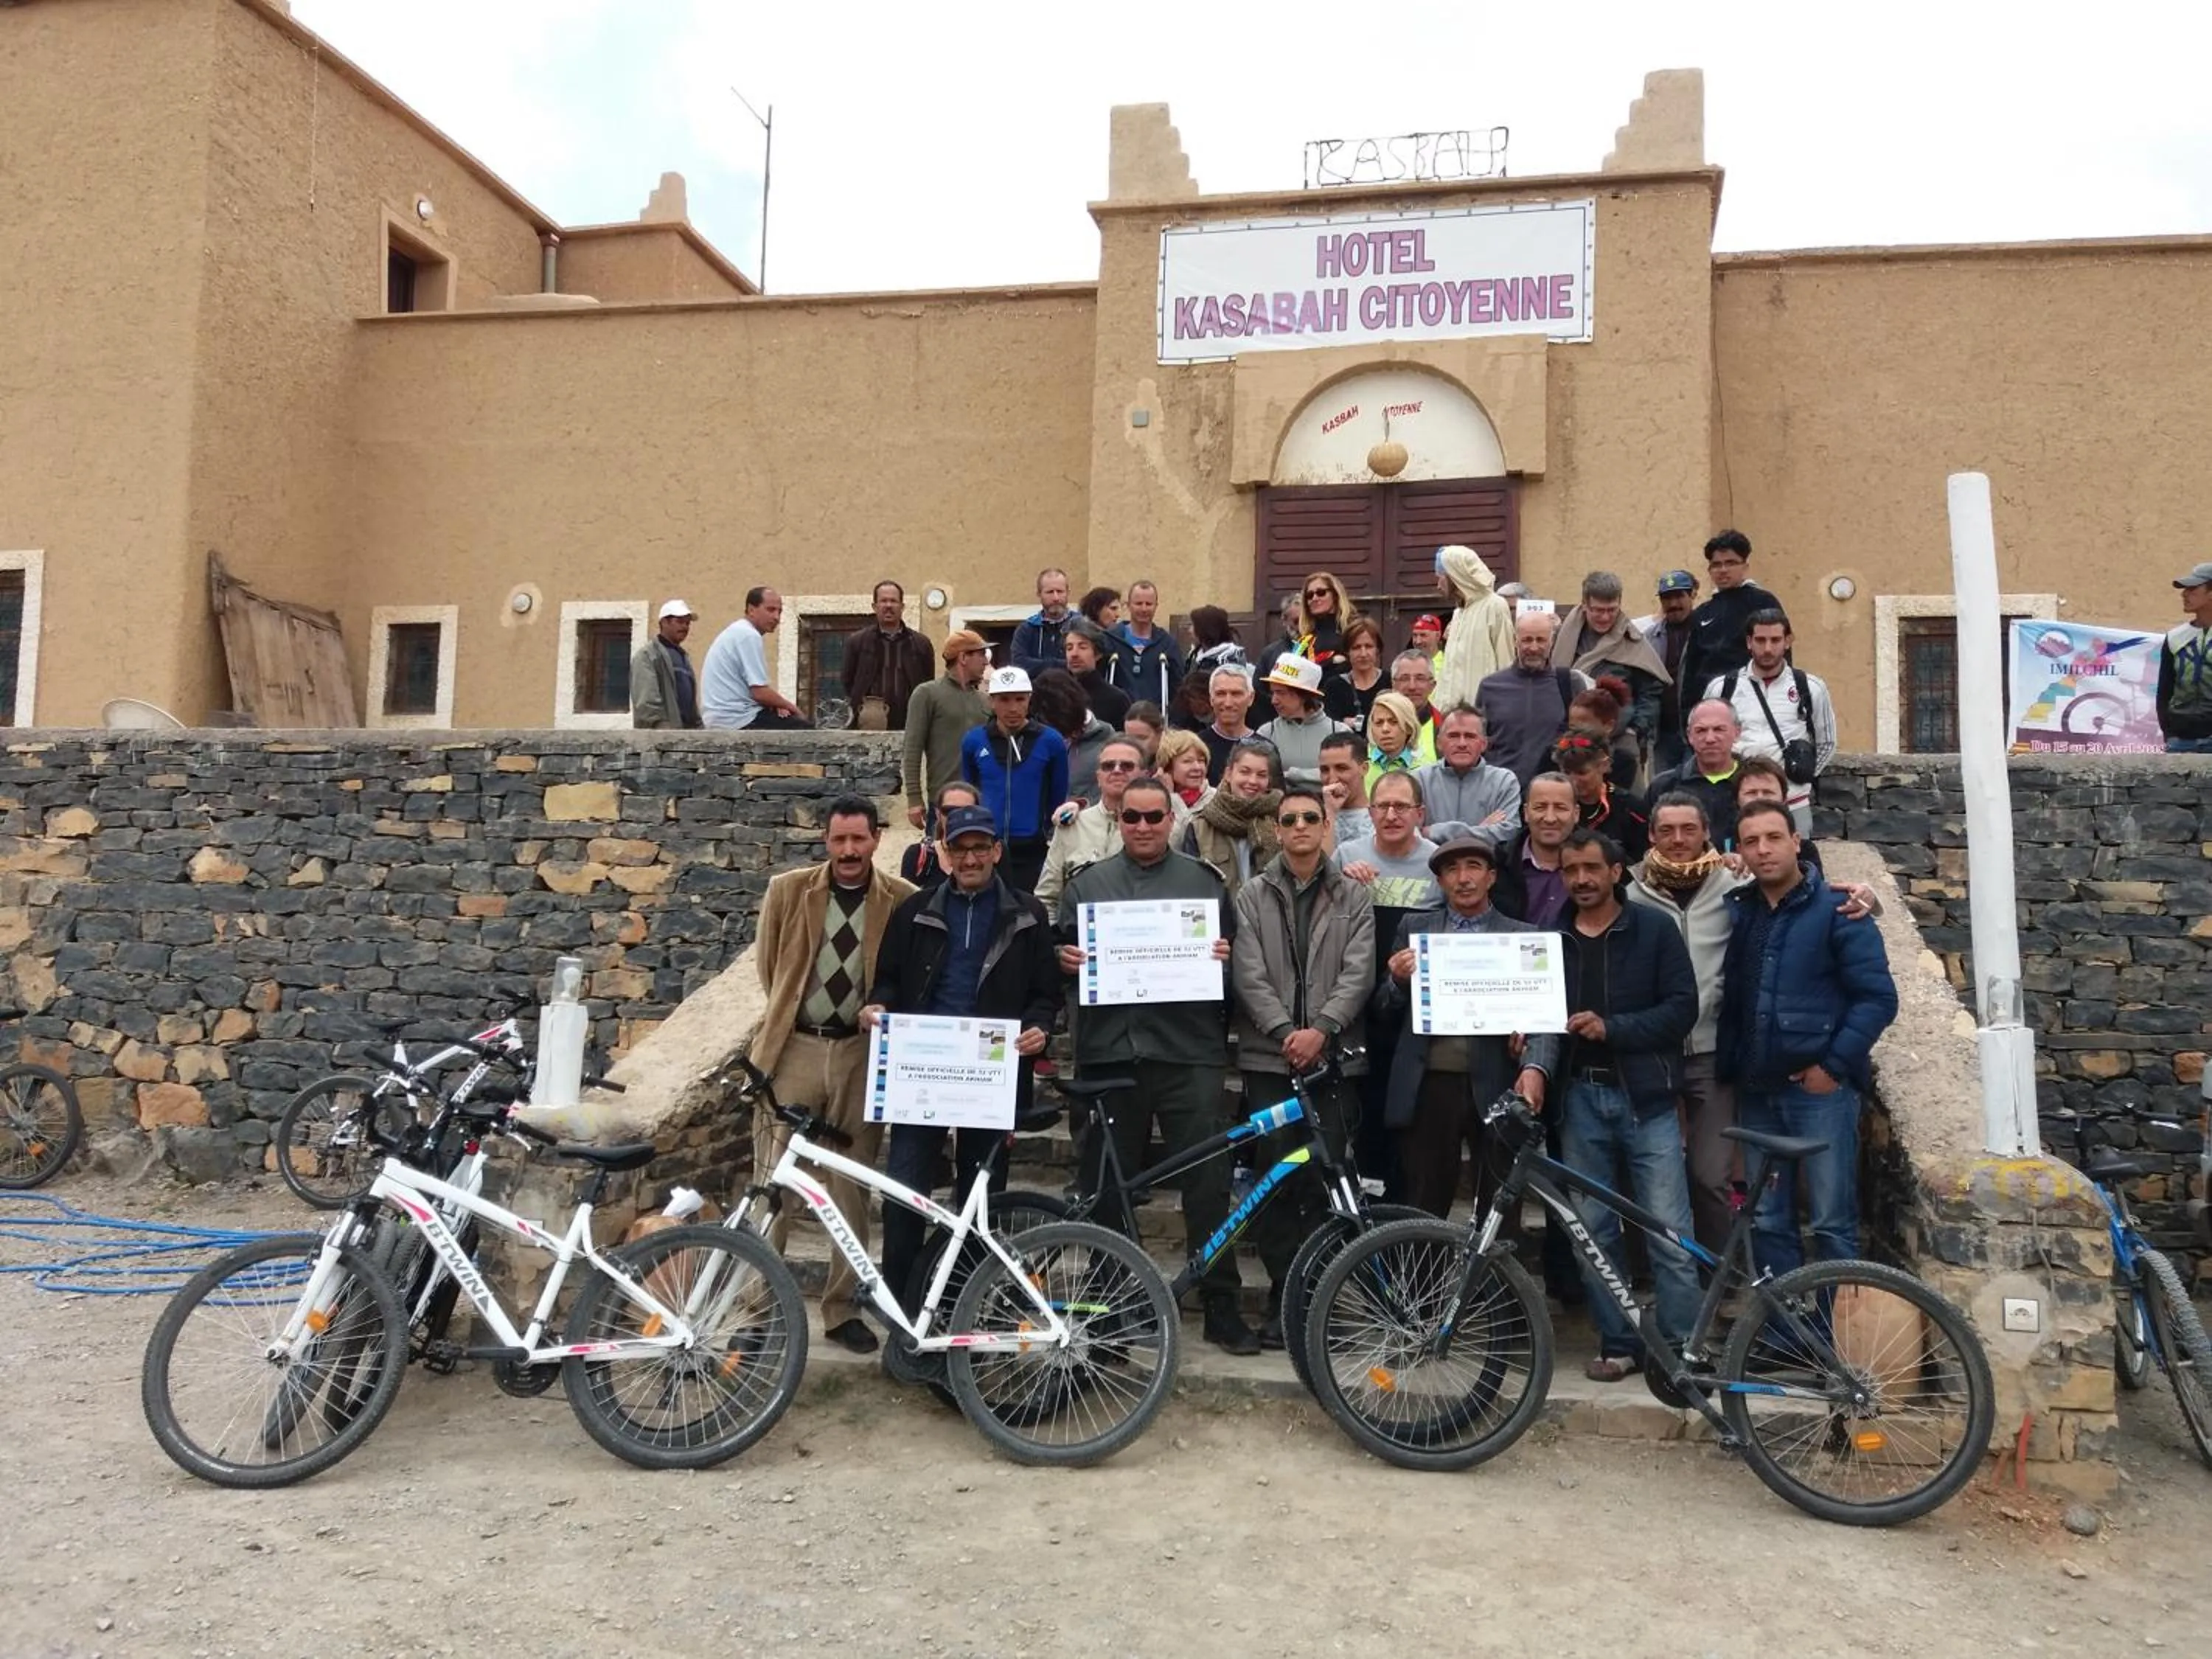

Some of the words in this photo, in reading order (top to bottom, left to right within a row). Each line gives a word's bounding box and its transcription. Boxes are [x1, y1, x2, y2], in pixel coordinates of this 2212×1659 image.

[1316, 229, 1436, 278] HOTEL
[1173, 288, 1348, 340] KASABAH
[1359, 274, 1575, 330] CITOYENNE
[1321, 404, 1359, 434] KASBAH
[2050, 663, 2118, 676] IMILCHIL
